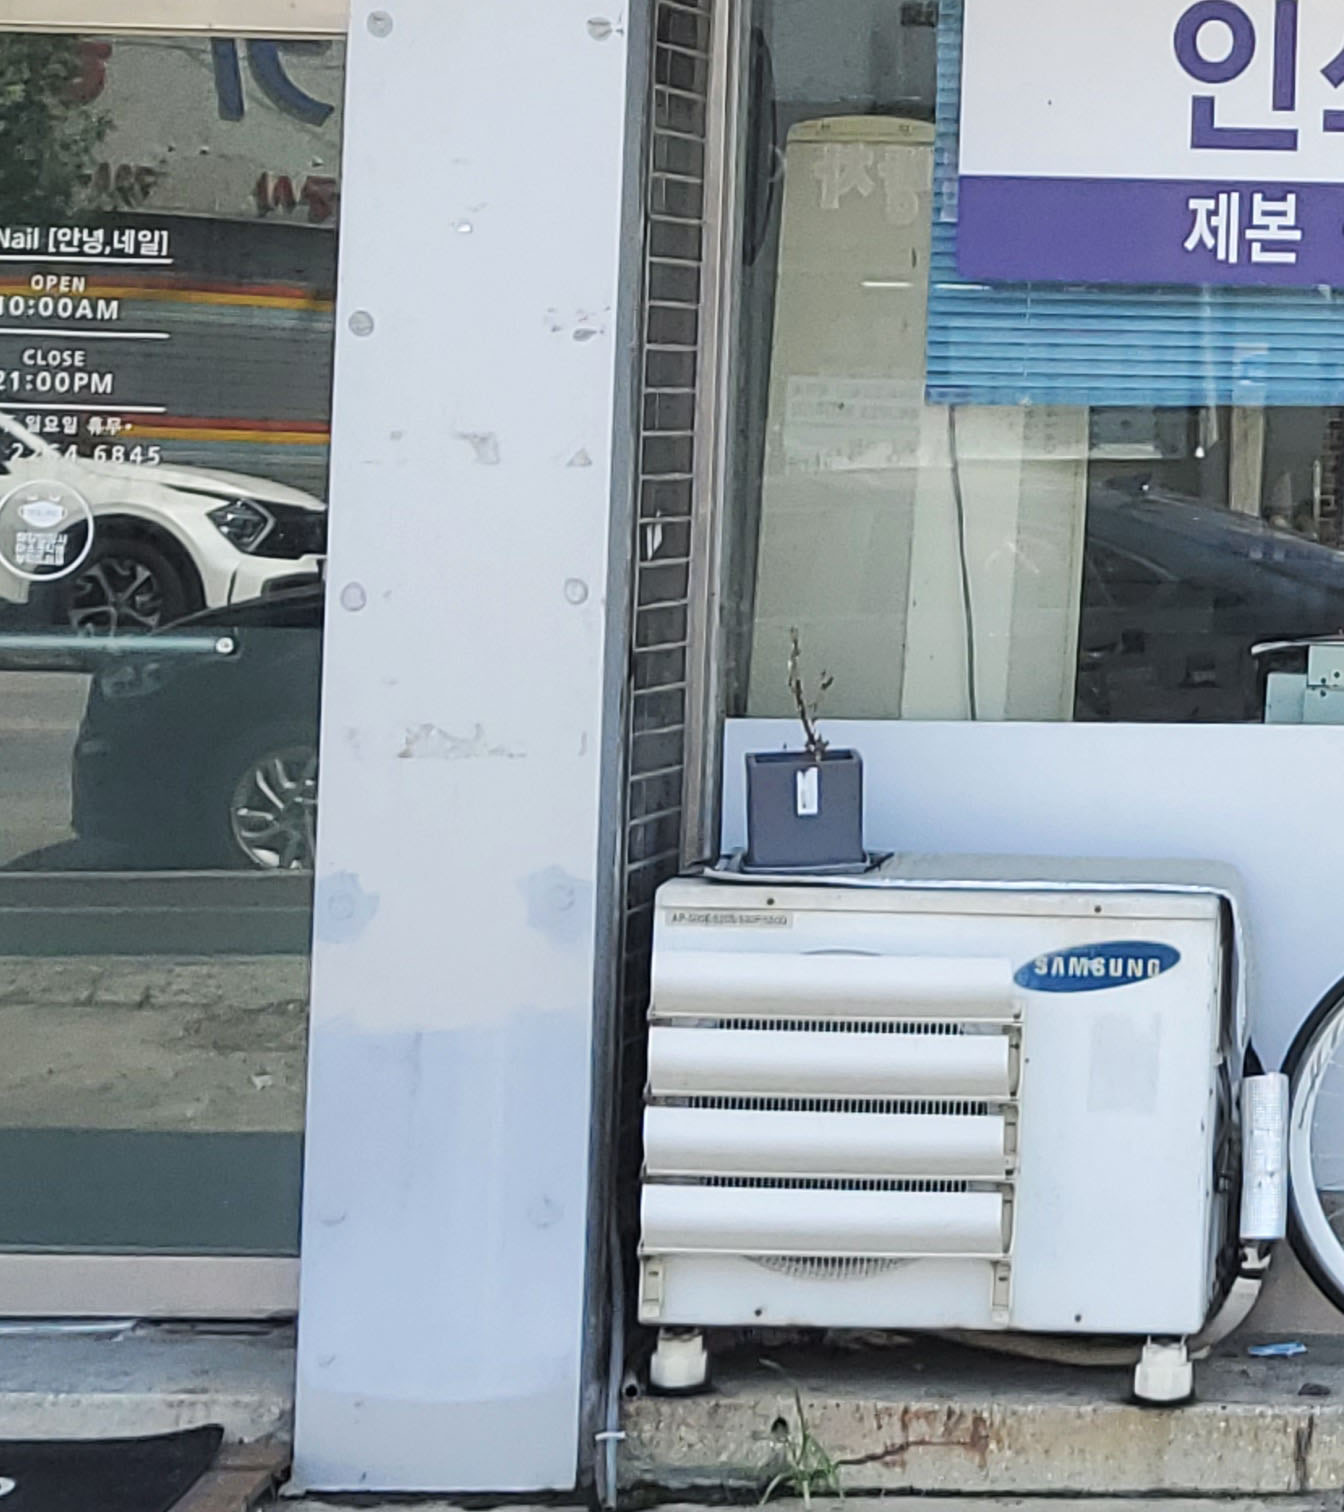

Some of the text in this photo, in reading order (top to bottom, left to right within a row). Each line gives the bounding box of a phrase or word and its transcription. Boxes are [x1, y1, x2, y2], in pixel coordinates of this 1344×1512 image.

[0, 227, 39, 250] Nail
[1183, 191, 1302, 264] 제본
[30, 274, 85, 293] OPEN
[22, 349, 86, 367] CLOSE
[1033, 955, 1161, 978] SAMSUNG
